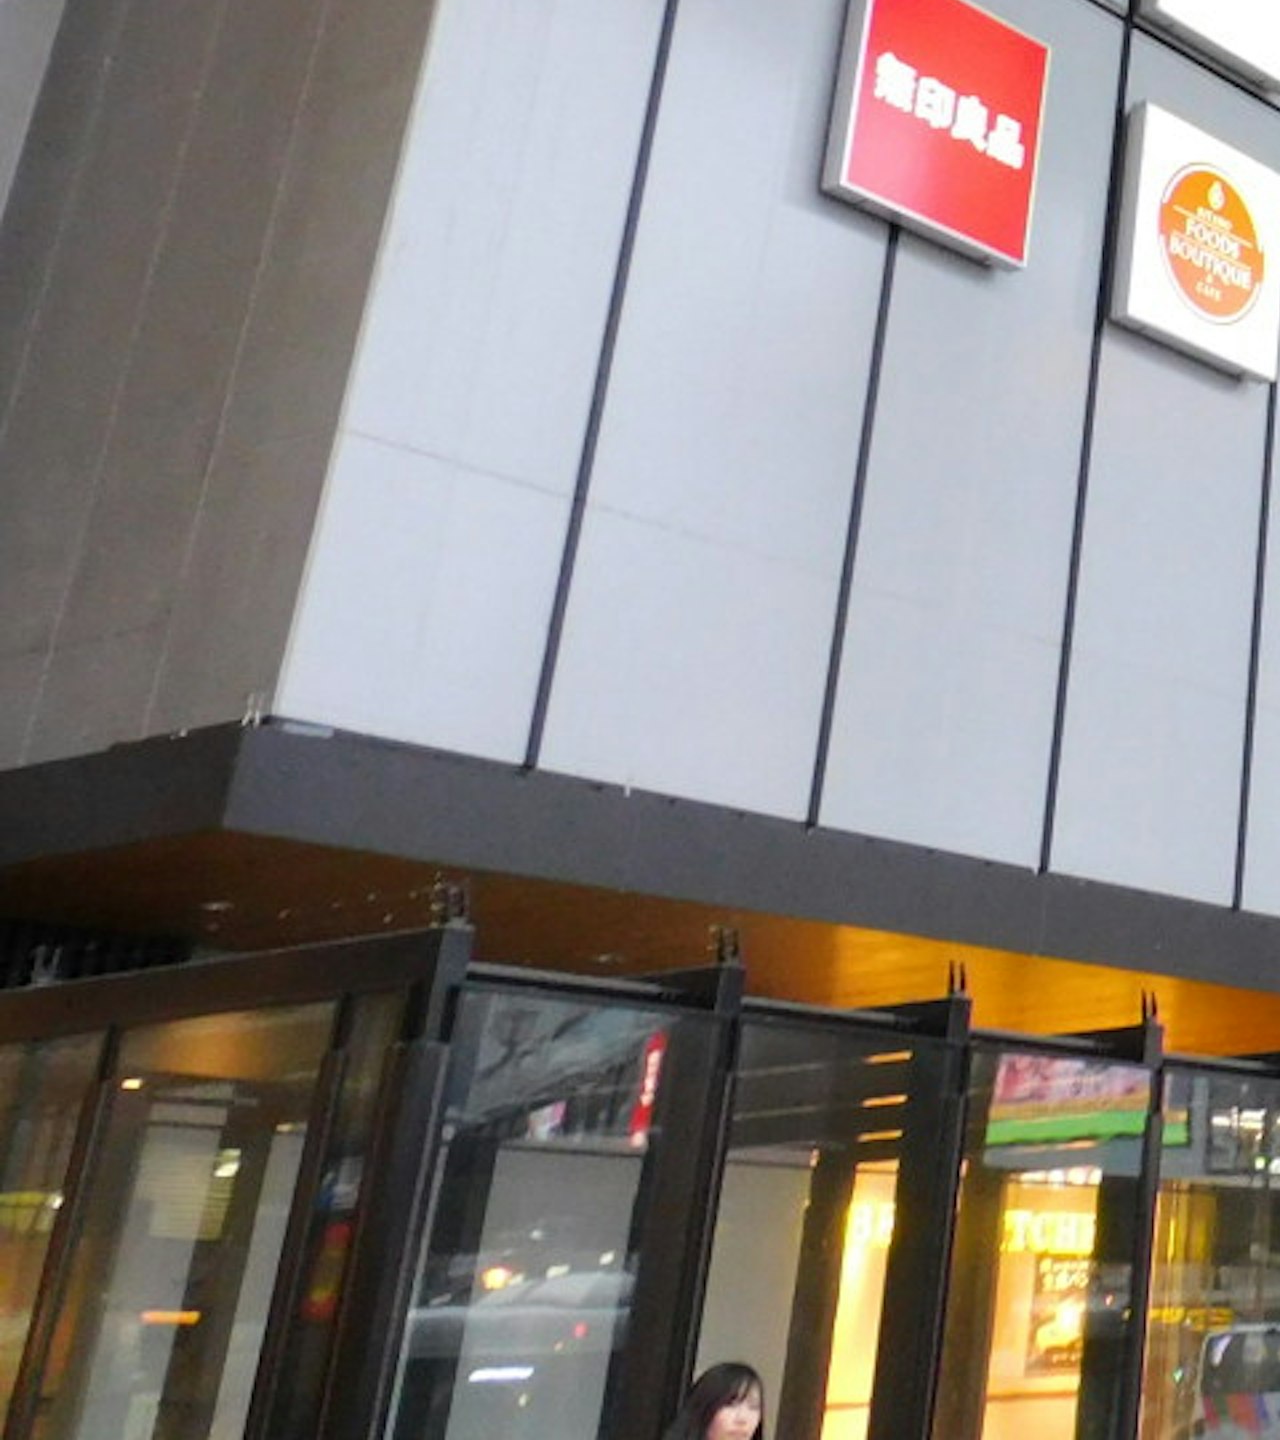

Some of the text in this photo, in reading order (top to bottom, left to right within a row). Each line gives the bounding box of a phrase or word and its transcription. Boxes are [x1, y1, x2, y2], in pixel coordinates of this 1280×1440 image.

[874, 52, 1025, 171] 無印良品
[1170, 233, 1252, 291] BOUTIQUE
[1186, 217, 1240, 259] FOODS
